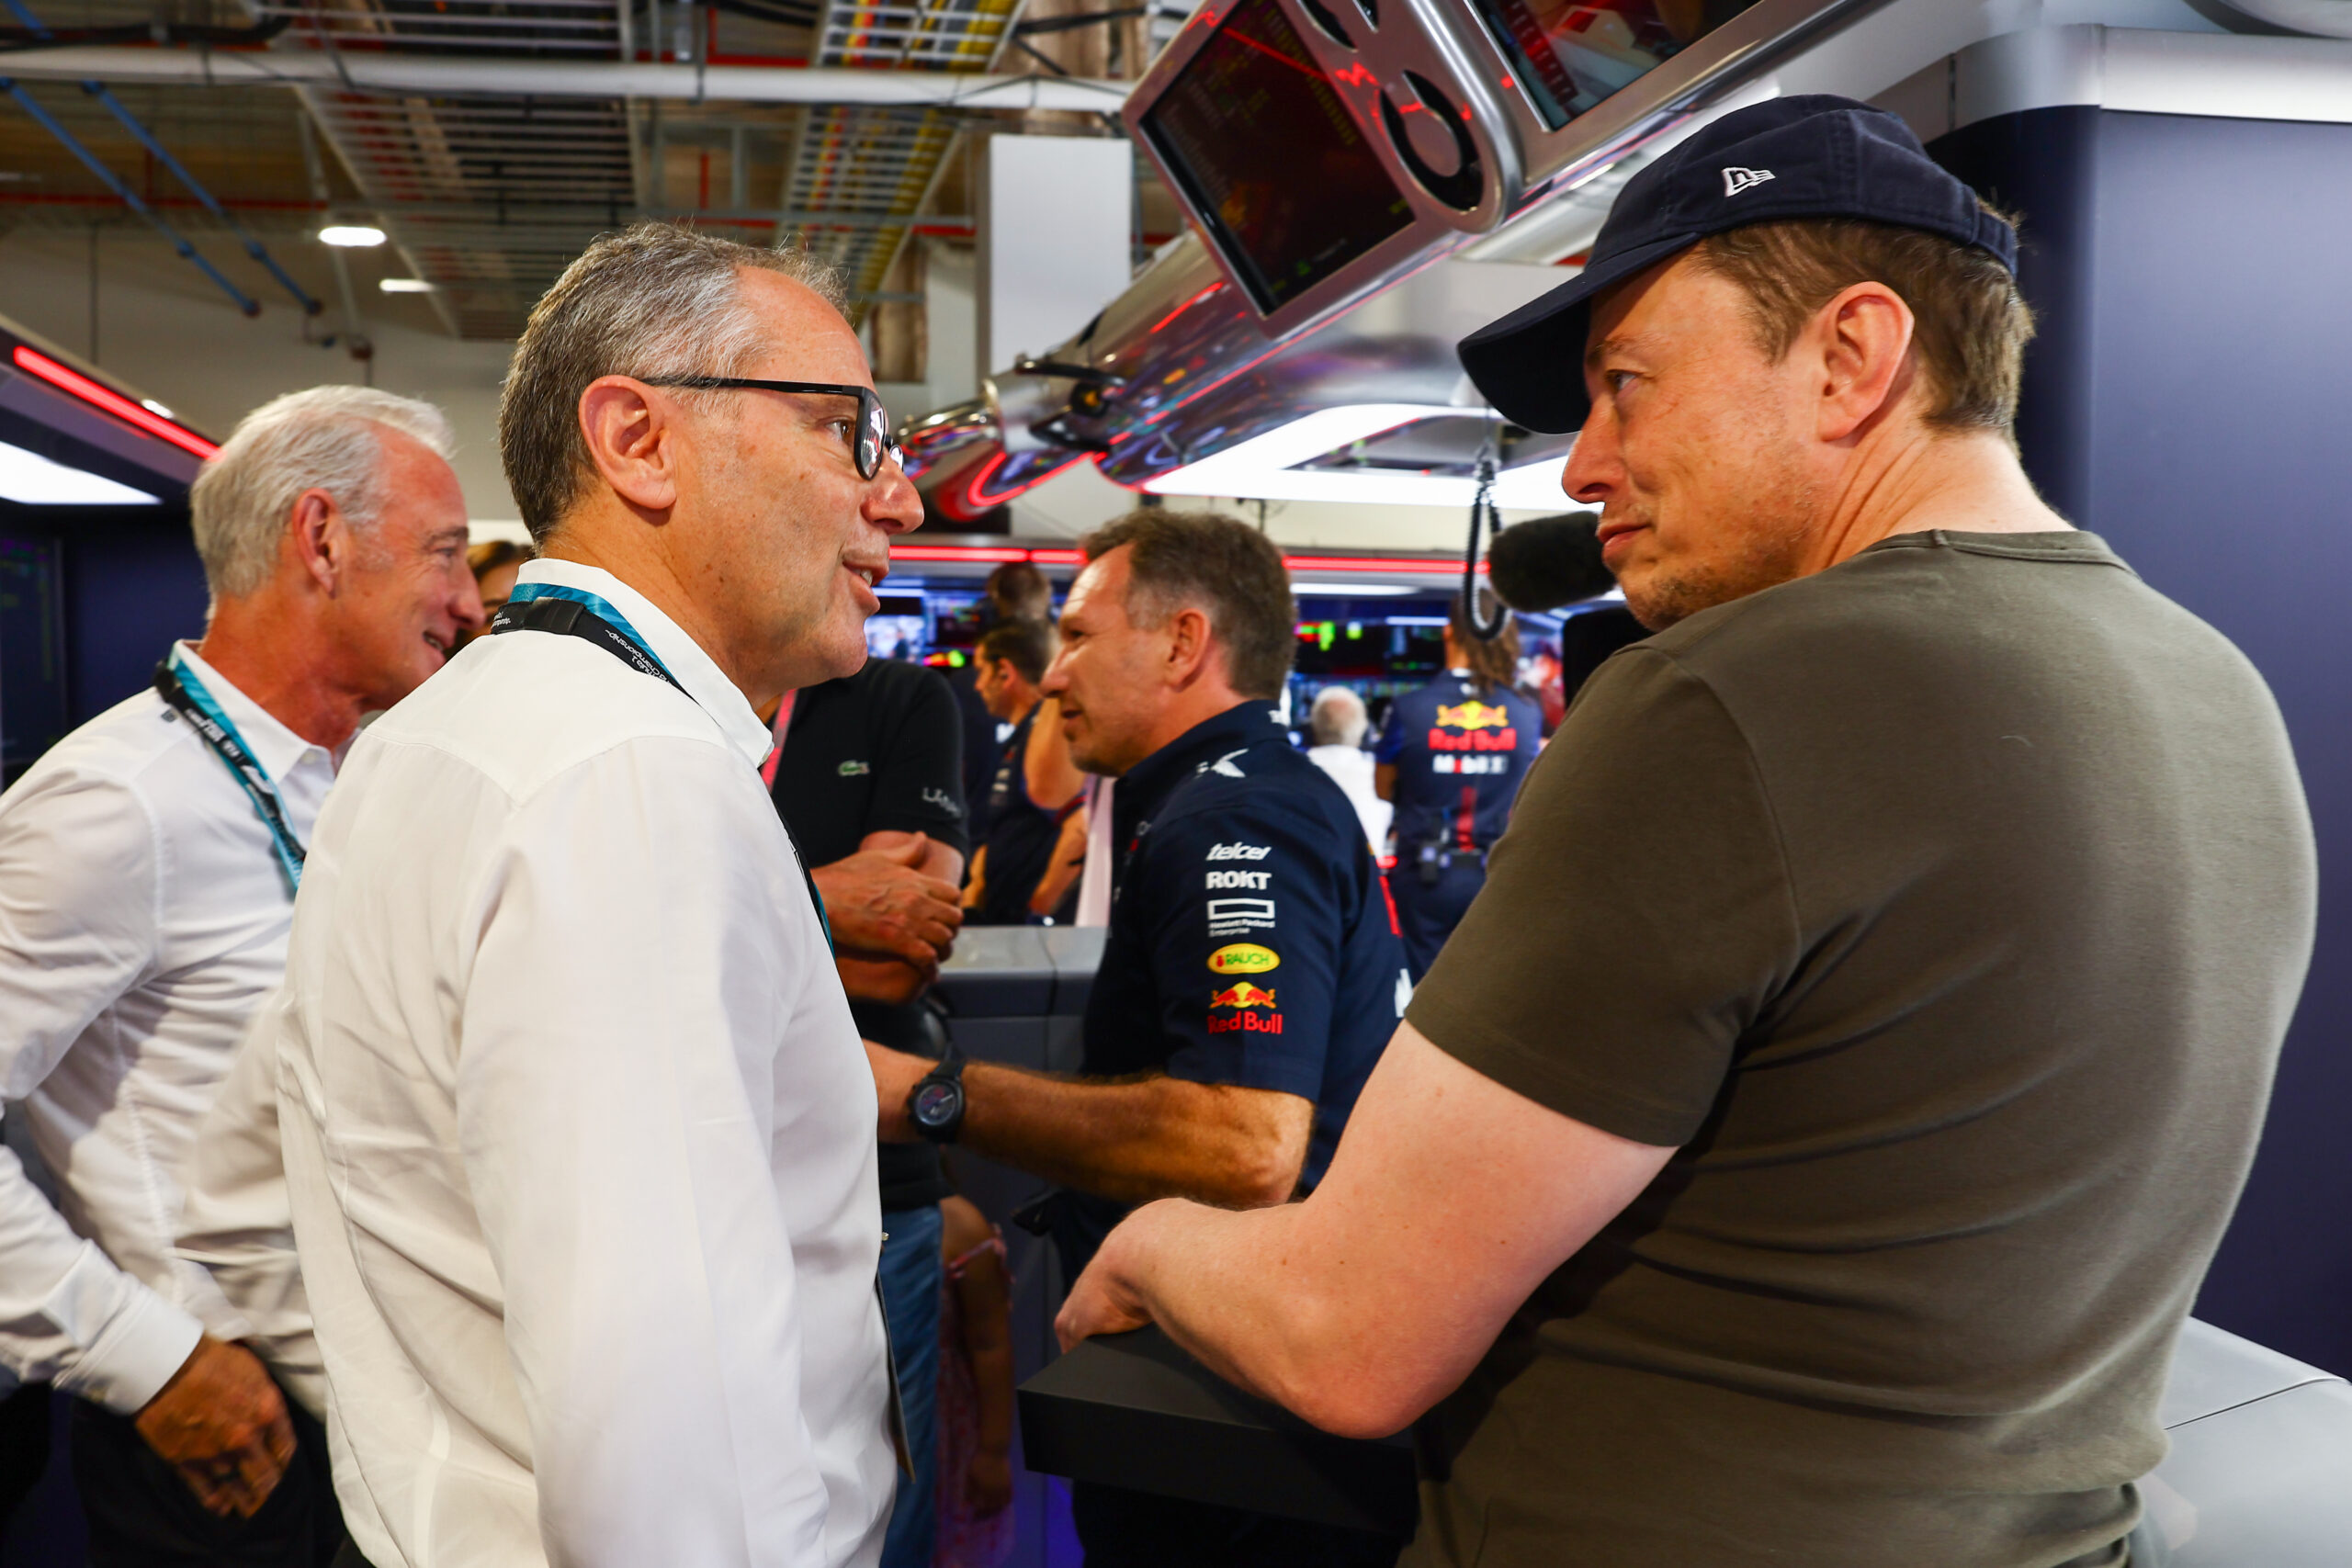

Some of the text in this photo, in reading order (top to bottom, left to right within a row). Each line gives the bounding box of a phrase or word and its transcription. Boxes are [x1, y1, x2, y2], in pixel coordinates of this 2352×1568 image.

[1205, 841, 1272, 861] telcel
[1205, 871, 1272, 890] ROKT
[1226, 953, 1270, 965] RAUCH
[1207, 1010, 1283, 1034] Red Bull
